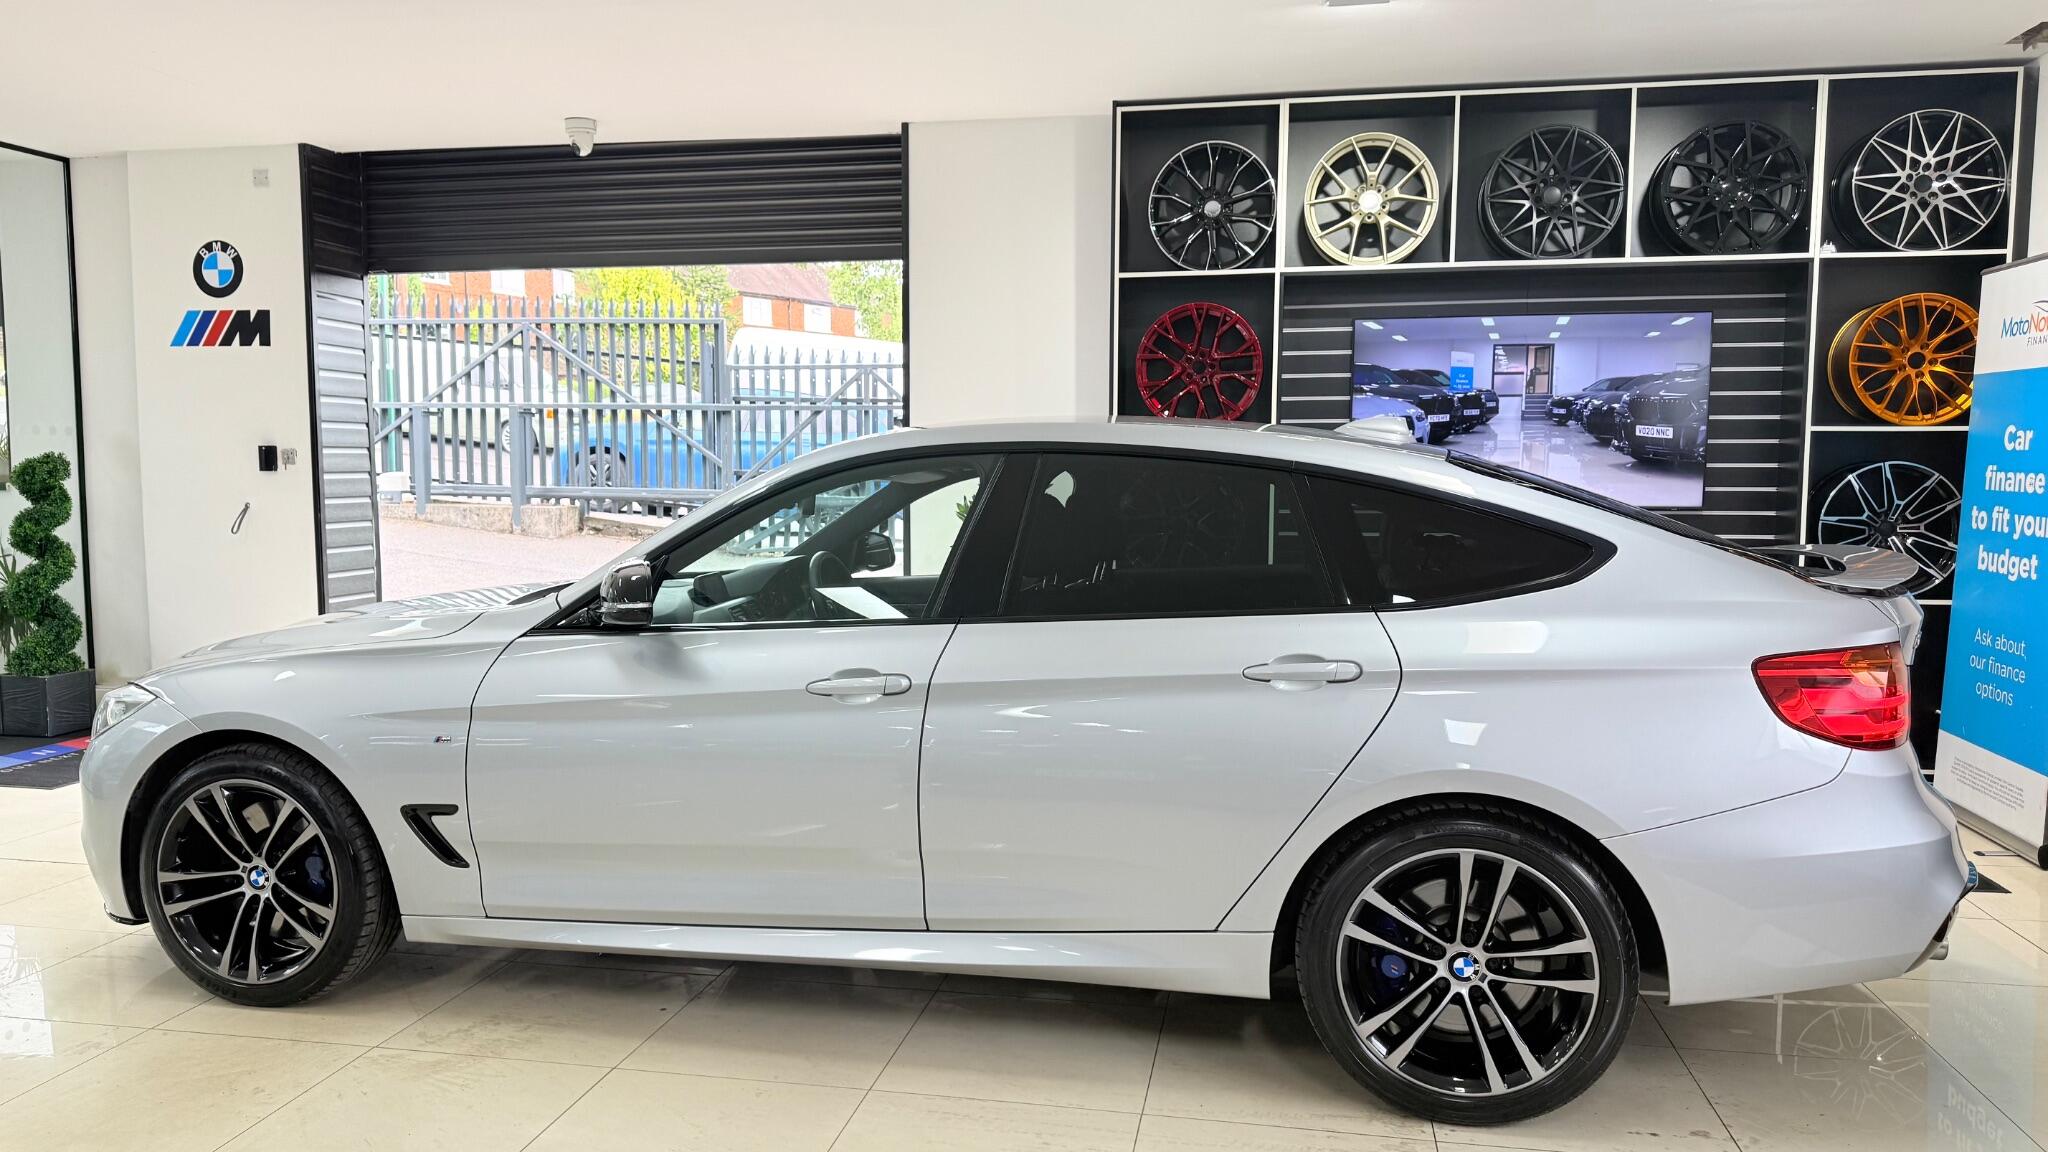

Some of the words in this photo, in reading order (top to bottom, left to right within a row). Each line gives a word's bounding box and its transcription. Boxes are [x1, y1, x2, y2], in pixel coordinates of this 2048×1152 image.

[199, 241, 238, 259] BMW
[2000, 311, 2048, 339] MotoNo
[2004, 424, 2034, 451] Car
[1985, 465, 2046, 494] finance
[1971, 505, 1988, 530] to
[1991, 505, 2010, 533] fit
[1977, 544, 2039, 582] budget
[1974, 627, 1993, 647] Ask
[1970, 655, 1986, 670] our
[1988, 656, 2026, 683] finance
[1975, 682, 2013, 706] options
